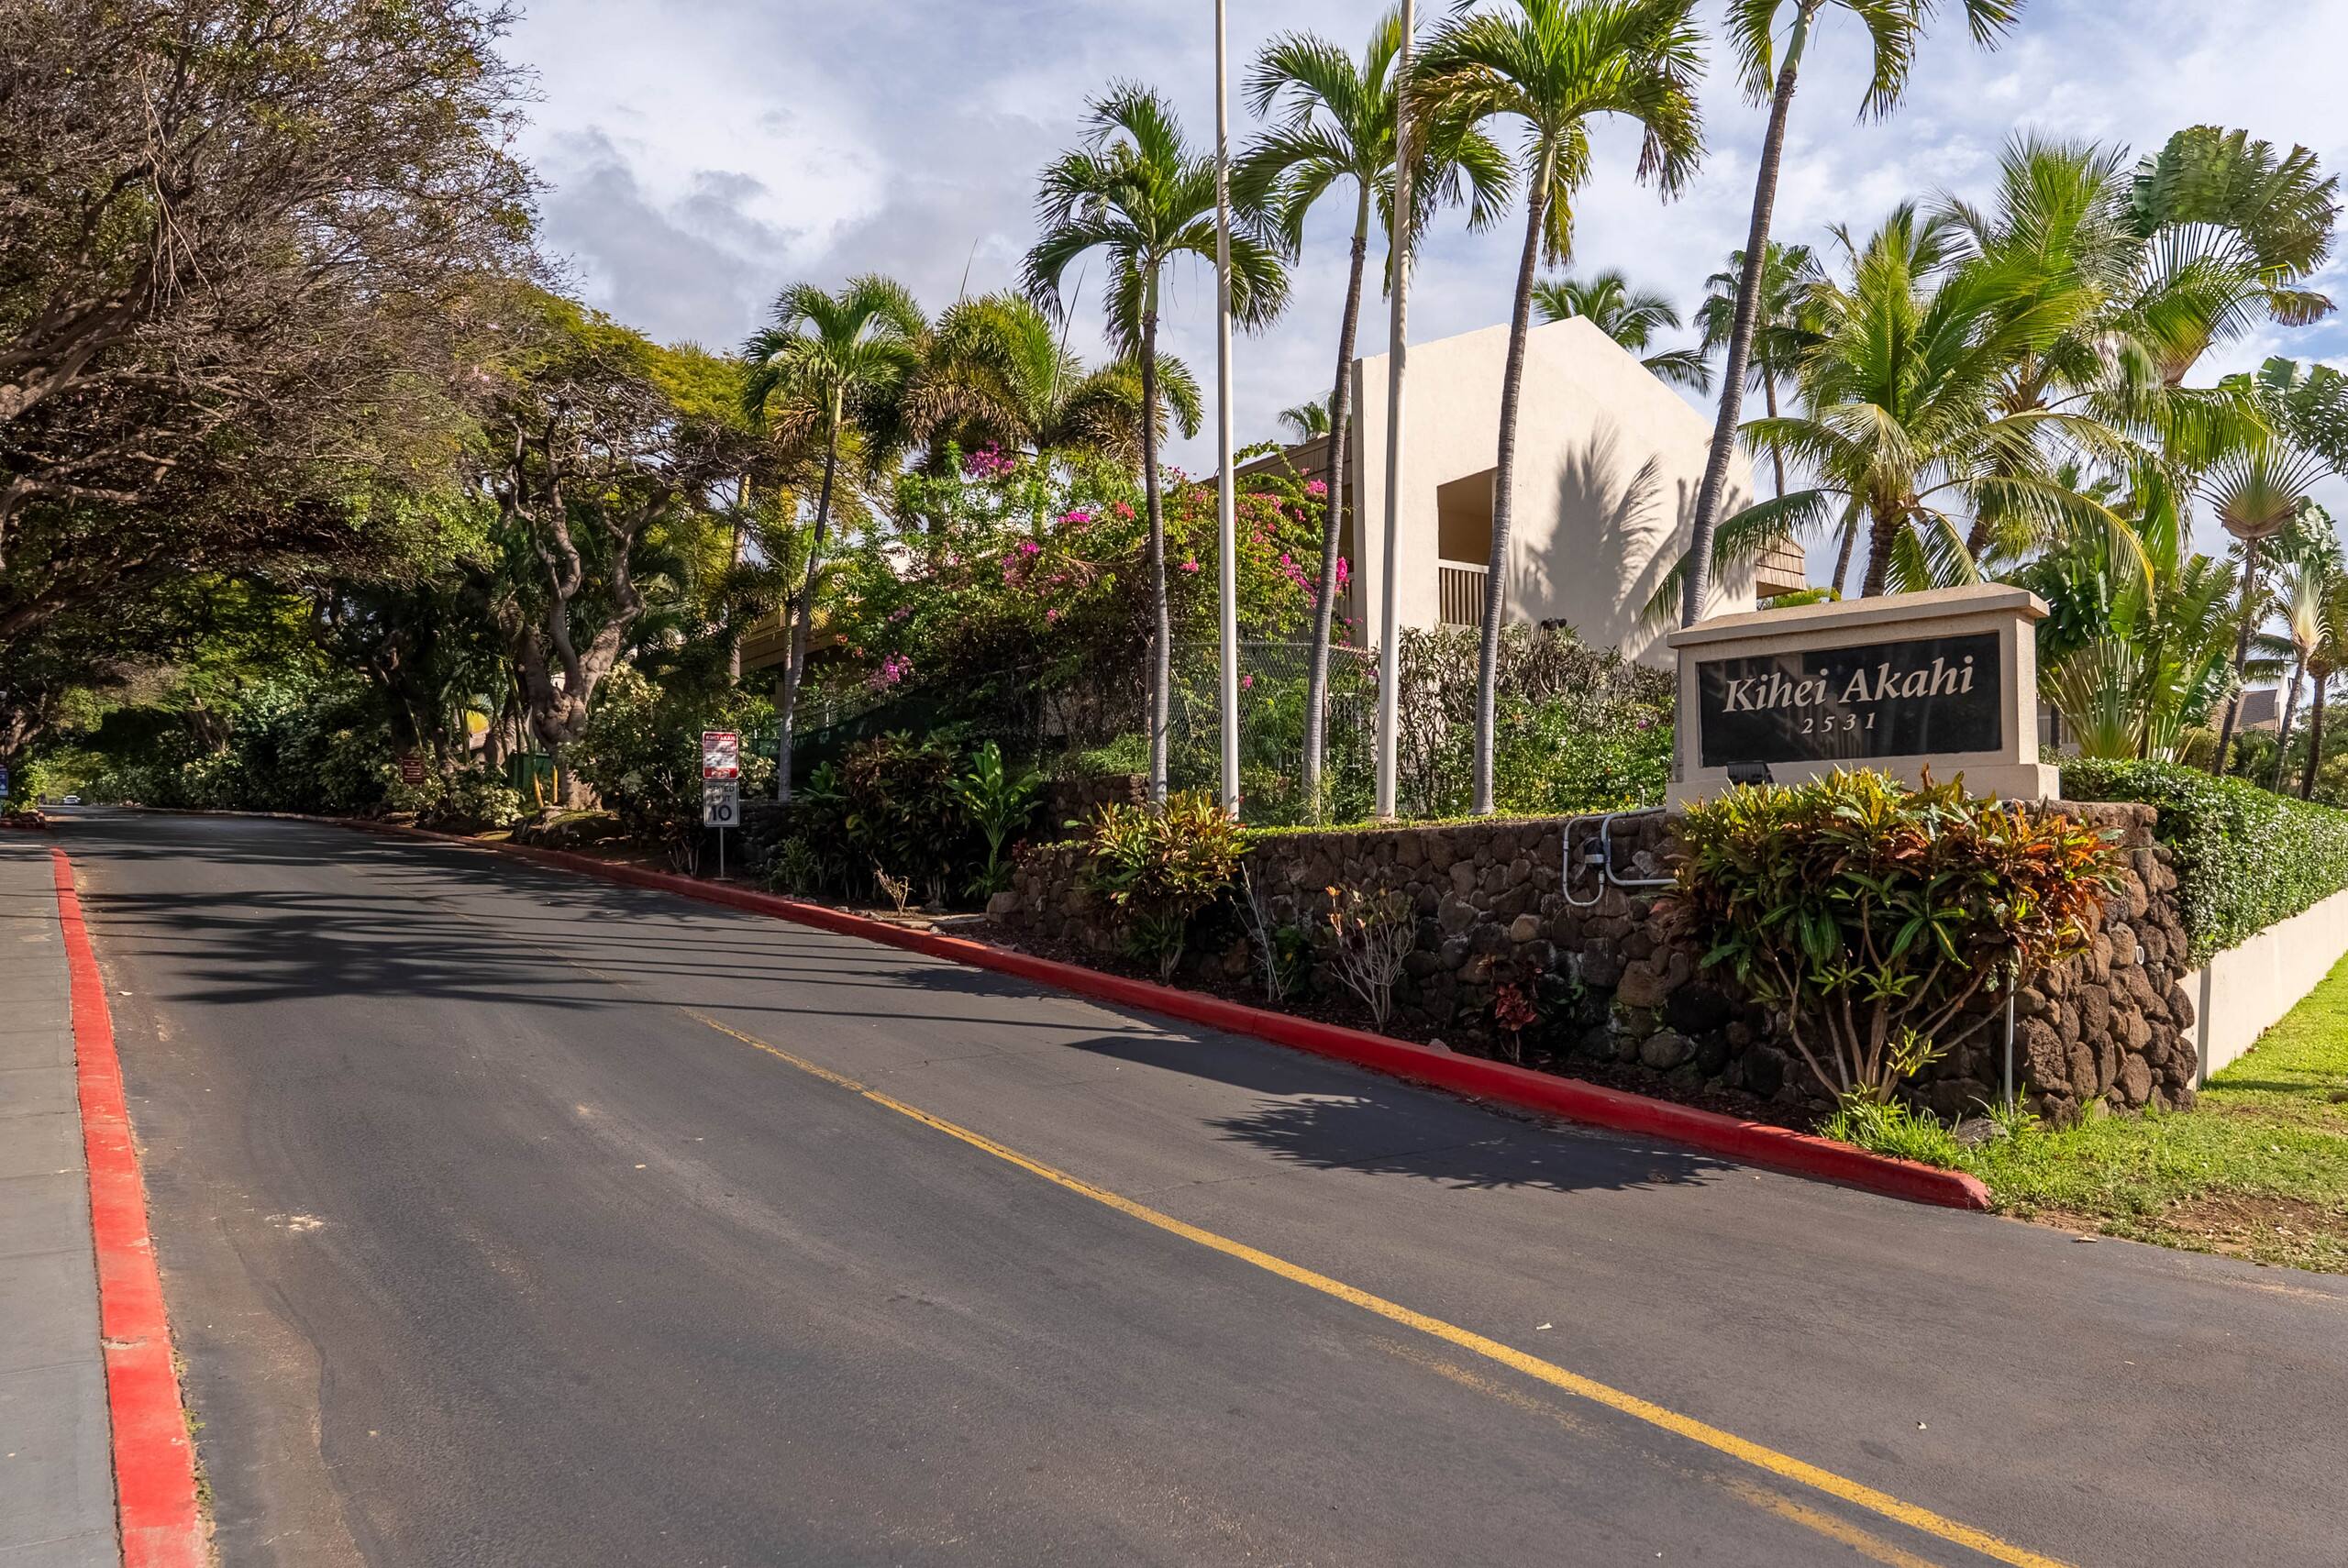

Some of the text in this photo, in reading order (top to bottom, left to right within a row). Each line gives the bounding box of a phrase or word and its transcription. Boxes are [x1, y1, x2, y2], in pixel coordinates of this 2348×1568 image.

[1722, 656, 1974, 713] Kihei Akahi
[1801, 712, 1876, 734] 2531
[711, 804, 732, 822] 10
